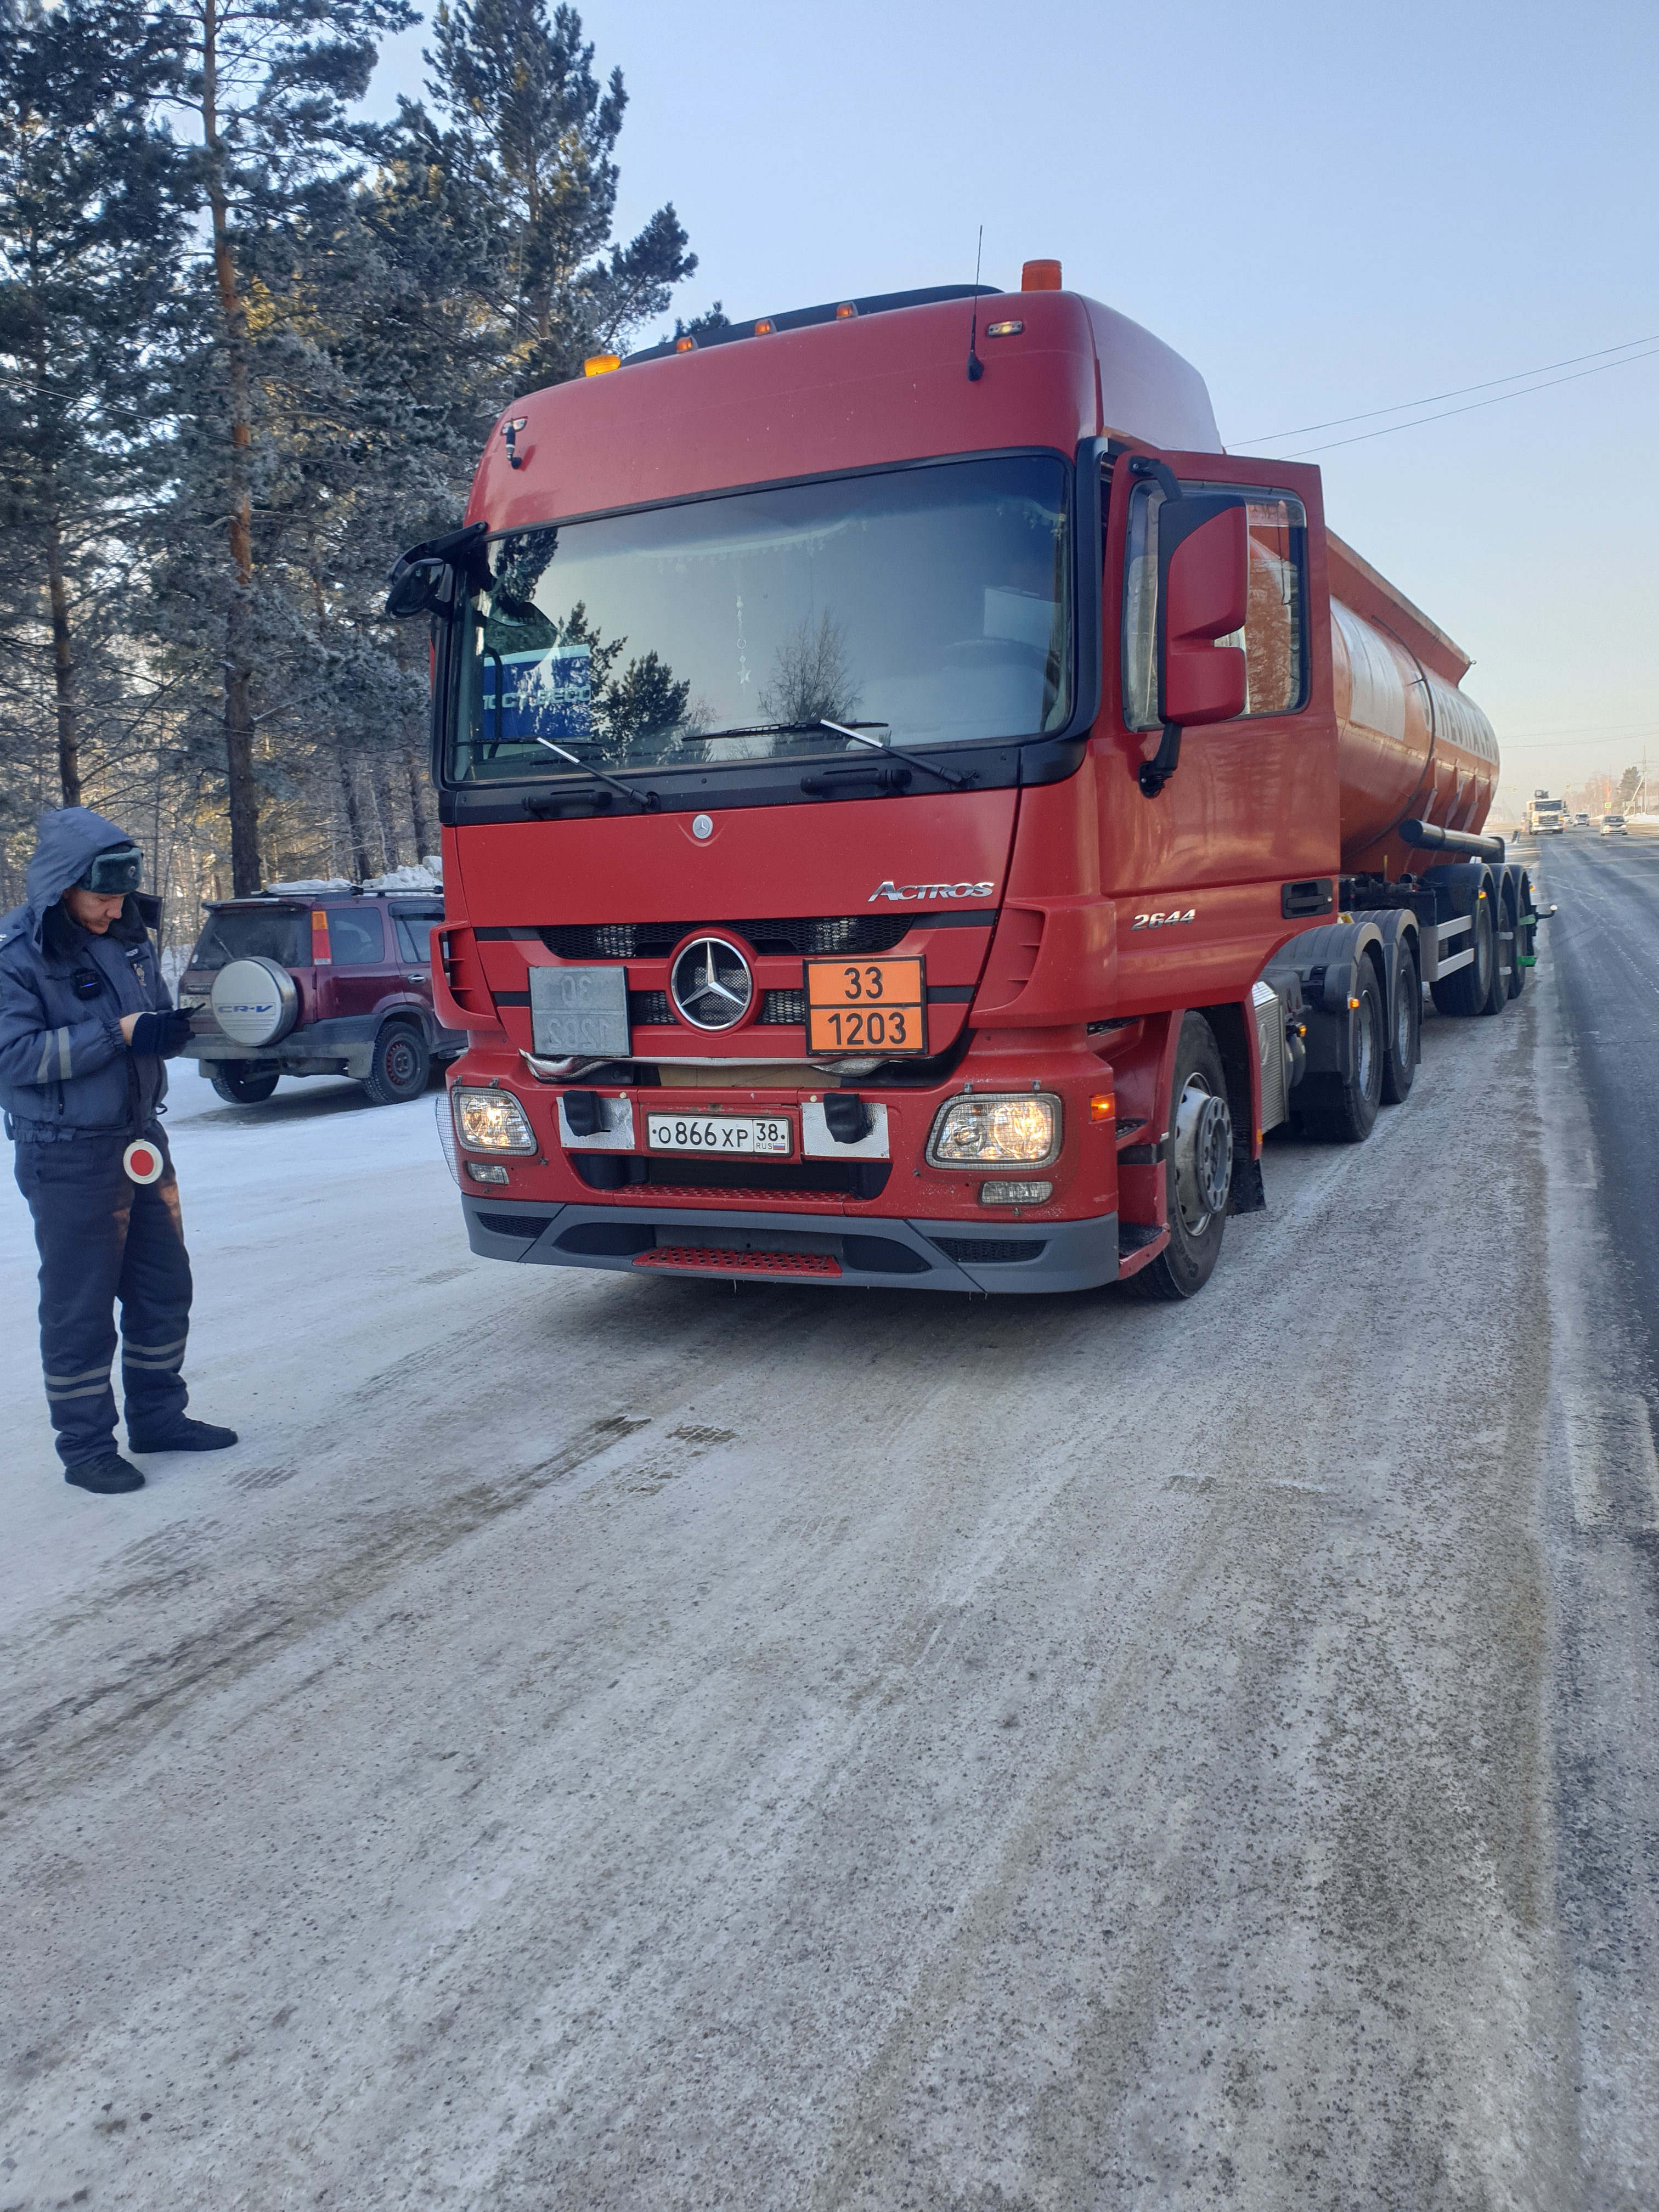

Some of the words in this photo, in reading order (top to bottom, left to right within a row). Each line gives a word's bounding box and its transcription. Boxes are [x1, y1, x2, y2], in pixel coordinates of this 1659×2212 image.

[1131, 909, 1196, 931] 2644
[844, 966, 883, 1000] 33
[218, 1005, 273, 1013] CR-V
[827, 1012, 906, 1046] 1203
[756, 1122, 778, 1142] 38
